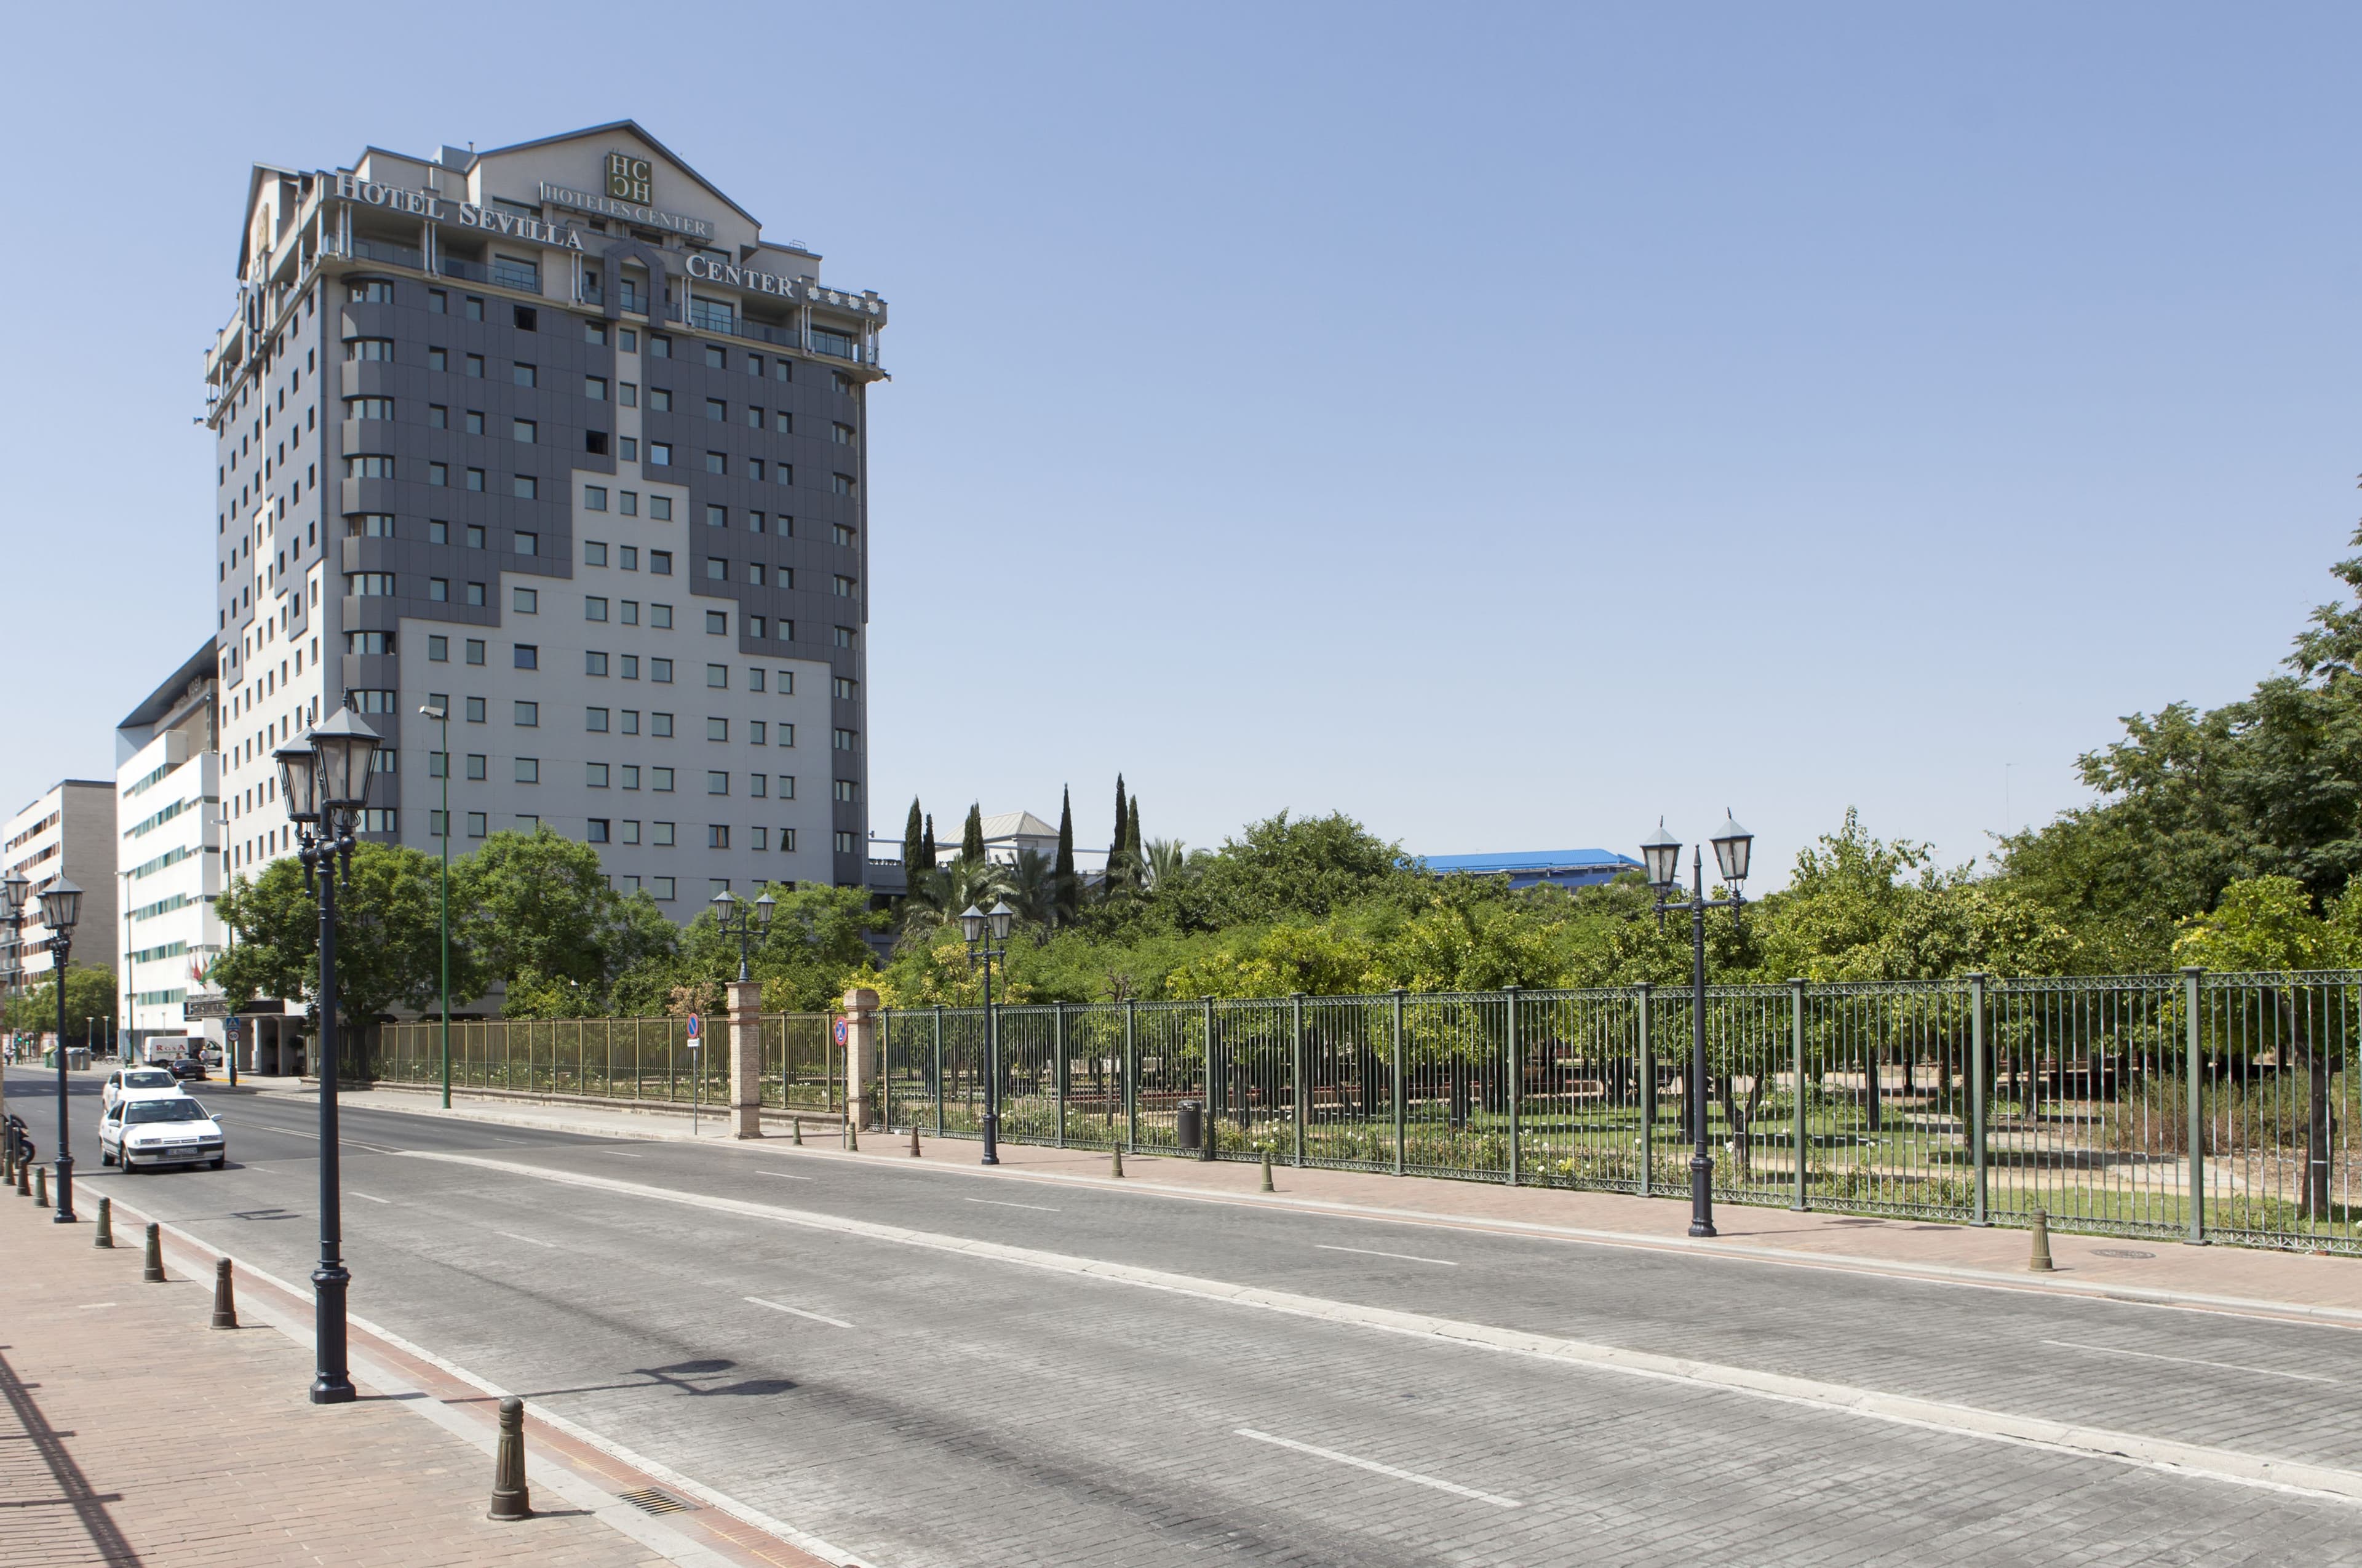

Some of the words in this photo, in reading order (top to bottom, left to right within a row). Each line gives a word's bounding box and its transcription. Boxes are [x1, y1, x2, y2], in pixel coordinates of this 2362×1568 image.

[611, 154, 647, 181] HC
[335, 173, 445, 220] HOTEL
[459, 201, 584, 250] SEVILLA
[685, 255, 794, 298] CENTER
[546, 185, 630, 217] HOTELES
[635, 208, 706, 236] CENTER
